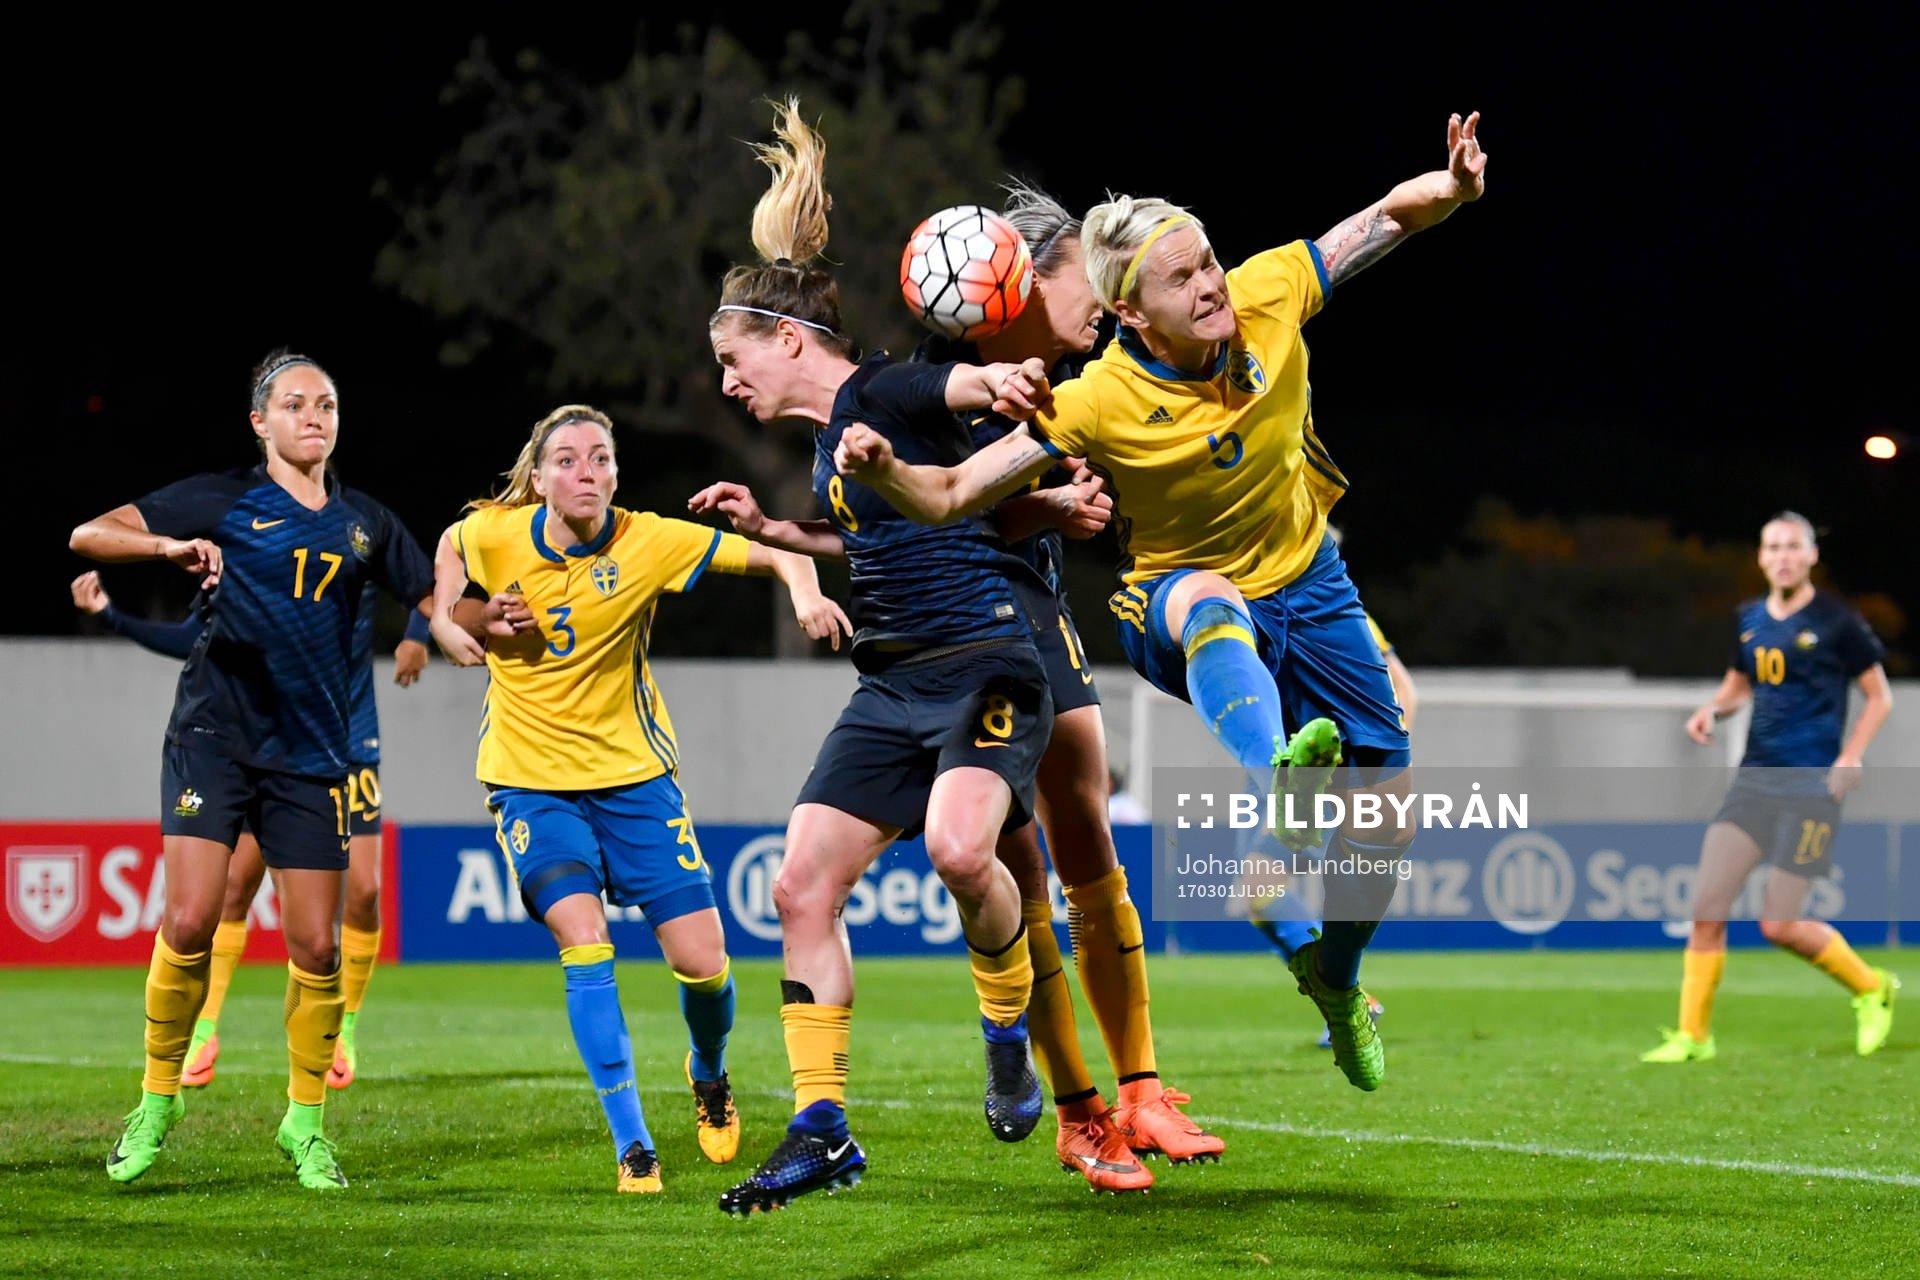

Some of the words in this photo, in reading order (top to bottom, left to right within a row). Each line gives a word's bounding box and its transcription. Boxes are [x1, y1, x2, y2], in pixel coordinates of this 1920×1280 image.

[1206, 432, 1244, 470] 5
[828, 475, 859, 532] 8
[294, 548, 343, 602] 17
[546, 606, 576, 657] 3
[1754, 646, 1785, 685] 10
[982, 694, 1013, 738] 8
[347, 767, 382, 813] 20
[666, 816, 701, 870] 3
[1798, 819, 1832, 859] 10
